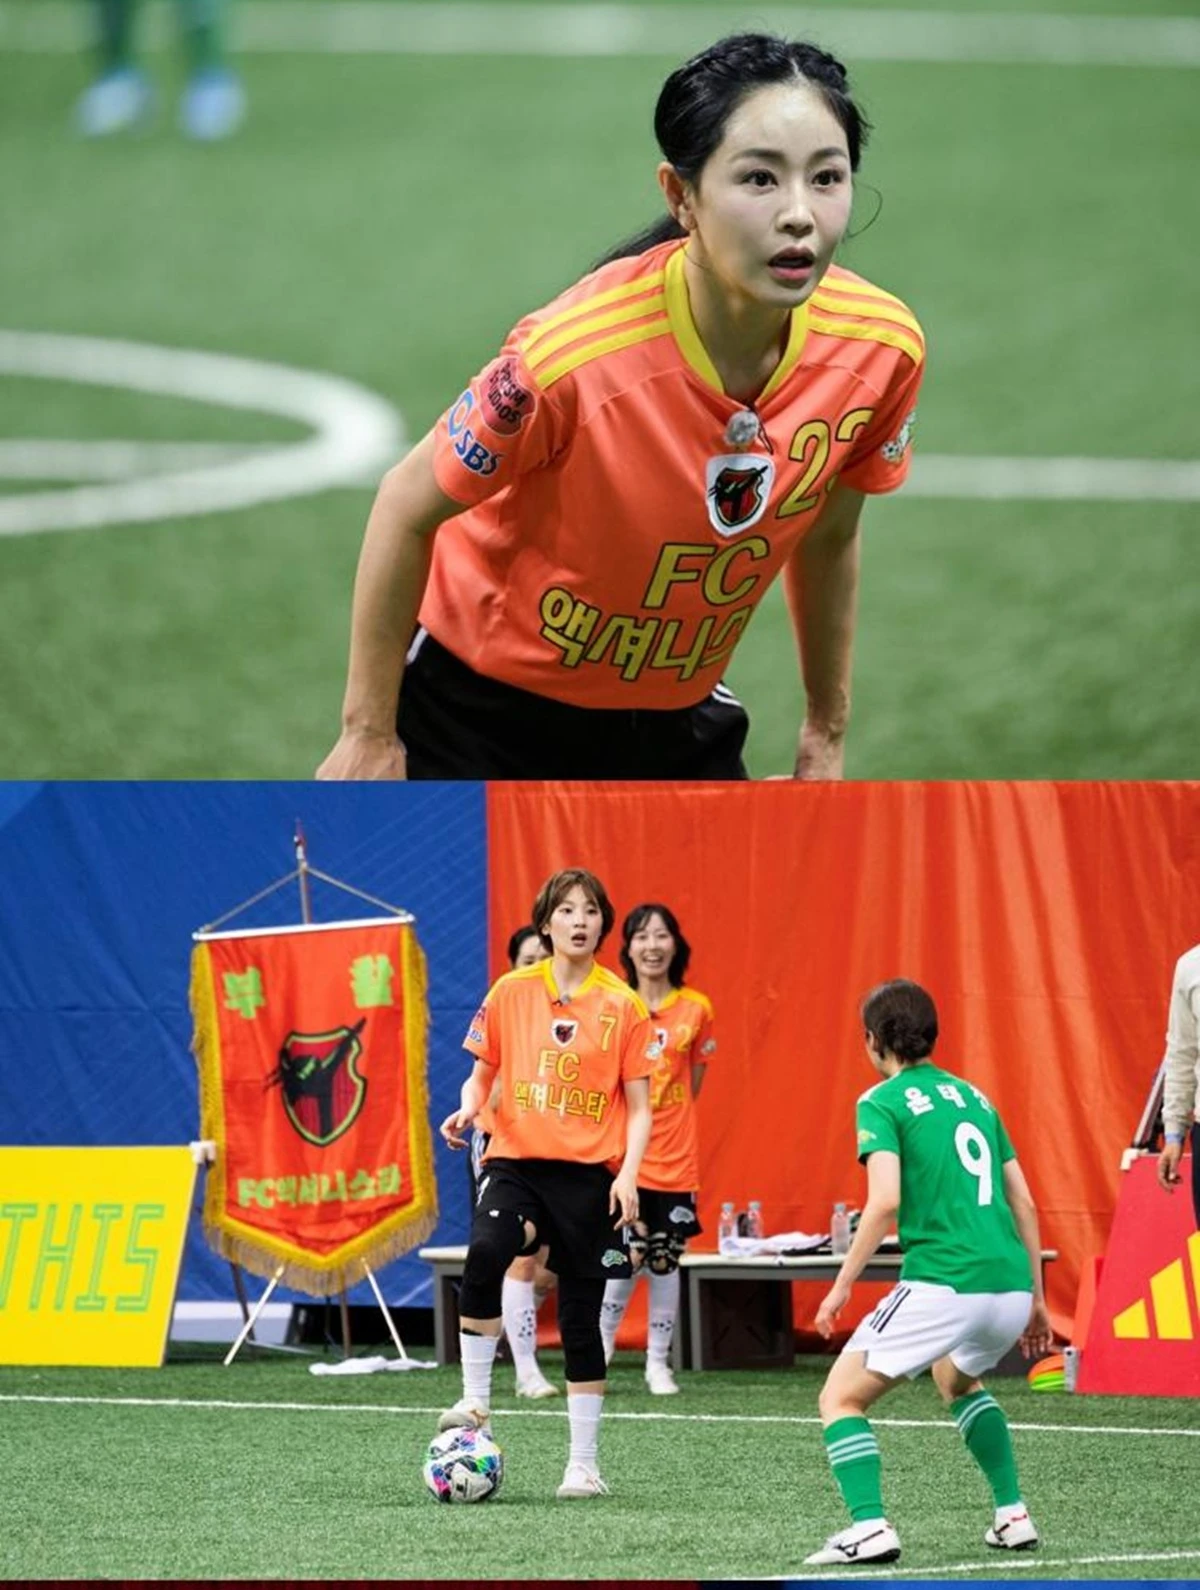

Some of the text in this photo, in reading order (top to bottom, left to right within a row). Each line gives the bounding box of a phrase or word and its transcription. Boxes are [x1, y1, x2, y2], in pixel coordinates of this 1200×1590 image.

[455, 429, 506, 475] SBS
[641, 536, 769, 609] FC
[600, 1015, 617, 1051] 7
[537, 1049, 580, 1082] FC
[513, 1080, 608, 1124] 액셔니스타
[954, 1121, 993, 1206] 9
[0, 1203, 165, 1311] THIS
